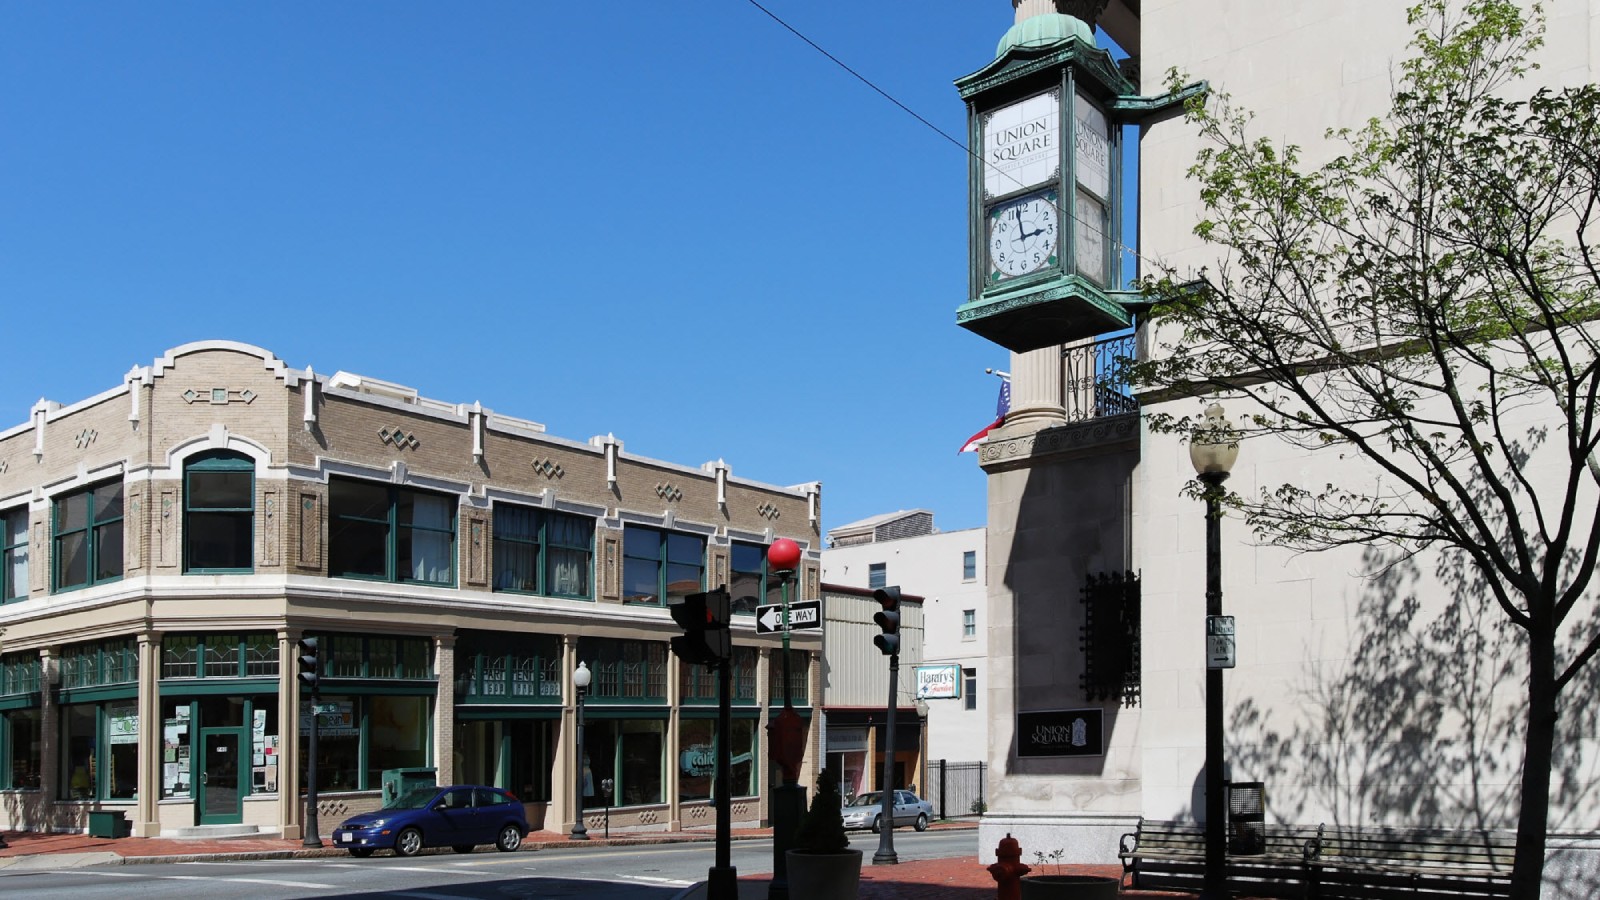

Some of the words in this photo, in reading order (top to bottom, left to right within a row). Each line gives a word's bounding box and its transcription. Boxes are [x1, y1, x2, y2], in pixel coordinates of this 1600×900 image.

[996, 118, 1046, 146] UNION
[1076, 118, 1104, 150] UNION
[993, 133, 1050, 164] SQUARE
[1075, 133, 1104, 167] SQUARE
[1019, 202, 1029, 213] 12
[1008, 210, 1014, 220] 11
[1043, 211, 1049, 221] 2
[998, 222, 1007, 233] 10
[1046, 224, 1053, 235] 3
[995, 239, 1001, 249] 9
[1042, 239, 1050, 250] 4
[999, 252, 1005, 262] 8
[1033, 252, 1040, 263] 5
[1008, 260, 1014, 270] 7
[1020, 260, 1027, 270] 6
[775, 611, 792, 624] OE
[795, 609, 813, 621] WAY
[1036, 725, 1070, 735] UNION
[1032, 733, 1071, 744] SQUARE
